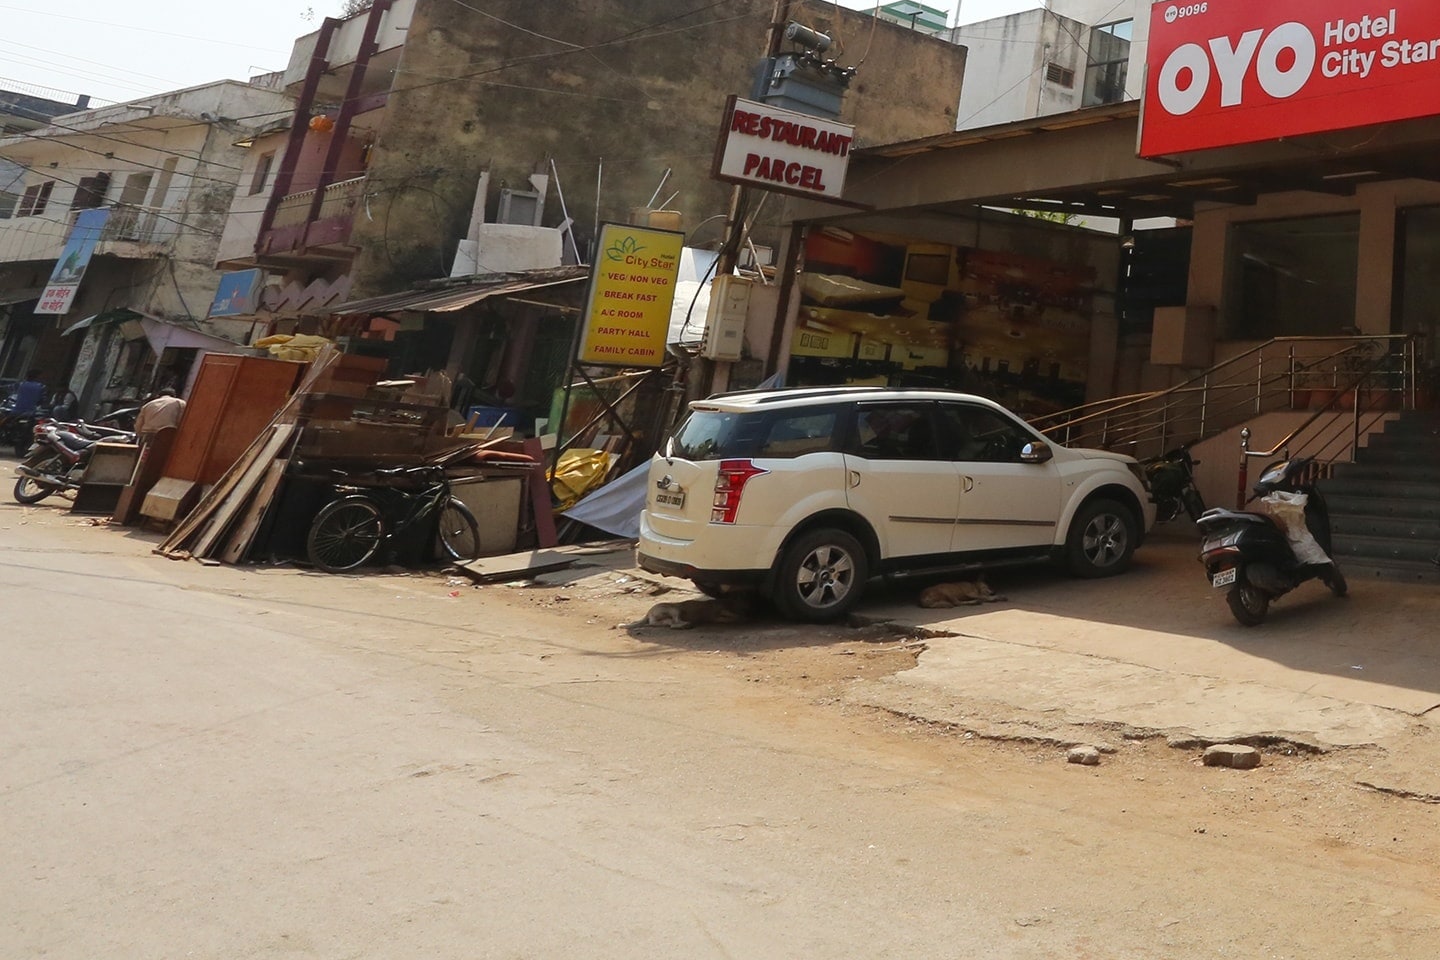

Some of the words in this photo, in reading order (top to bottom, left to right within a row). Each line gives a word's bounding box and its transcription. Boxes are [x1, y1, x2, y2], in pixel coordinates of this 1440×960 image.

[1178, 1, 1208, 19] 9096
[1323, 8, 1396, 47] Hotel
[1158, 21, 1316, 116] OYO
[1321, 49, 1376, 79] City
[731, 109, 852, 158] RESTAURANT
[743, 153, 826, 191] PARCEL
[625, 255, 649, 269] City
[650, 258, 675, 270] Star
[629, 275, 649, 284] NON
[651, 277, 668, 285] VEG
[604, 290, 634, 300] BREAK
[636, 294, 657, 302] FAST
[617, 310, 643, 319] ROOM
[597, 327, 626, 336] PARTY
[628, 329, 651, 338] HALL
[594, 345, 626, 355] FAMILY
[628, 347, 655, 356] CABIN
